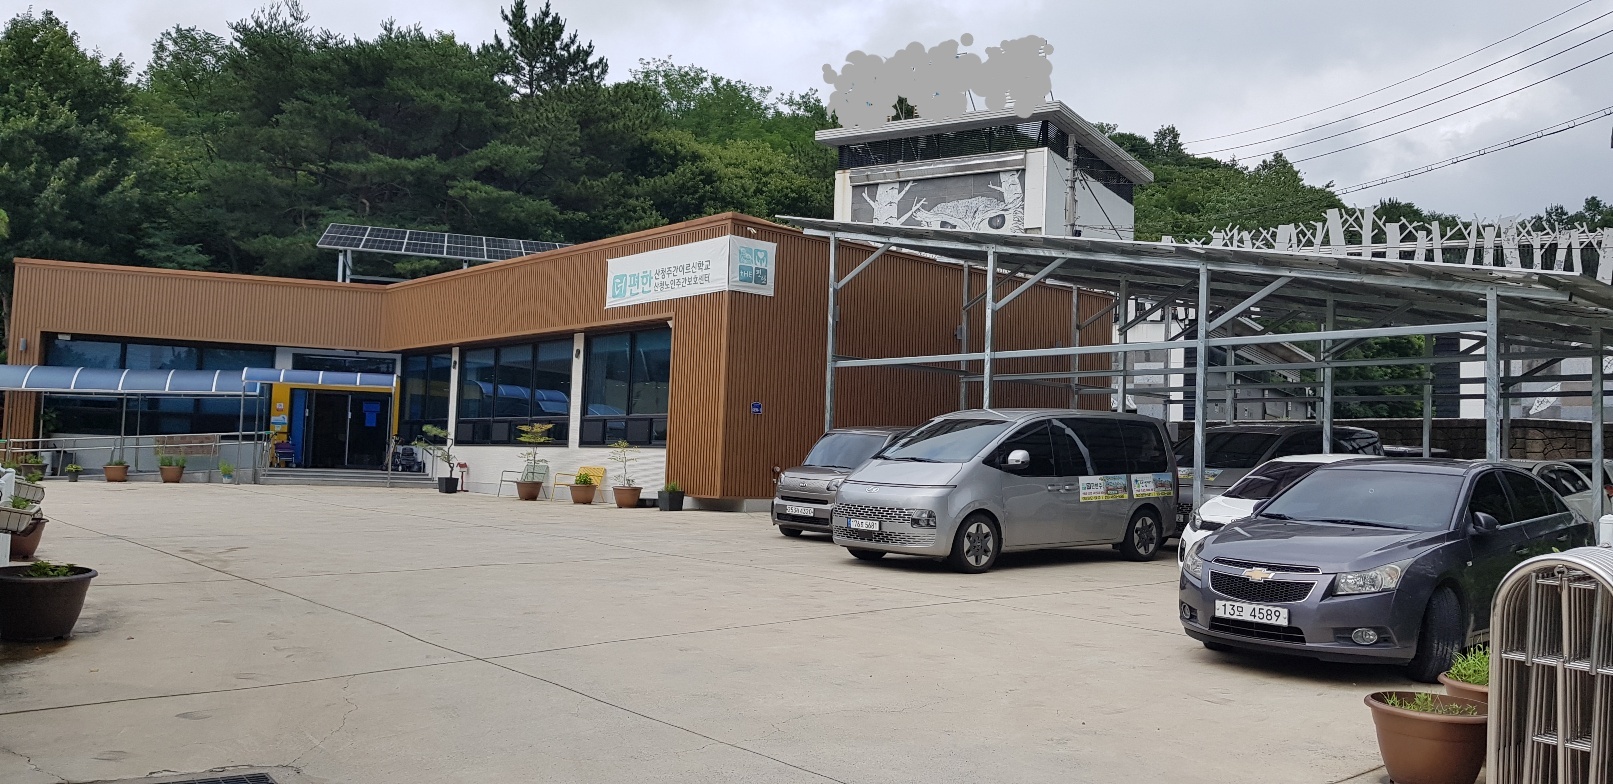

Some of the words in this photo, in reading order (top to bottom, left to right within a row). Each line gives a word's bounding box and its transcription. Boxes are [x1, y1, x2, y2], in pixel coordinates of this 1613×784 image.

[654, 260, 711, 280] 산청주간어르신학교
[653, 273, 711, 292] 산청노인주간보호센터
[1222, 603, 1243, 617] 13모
[1250, 607, 1281, 622] 4589
